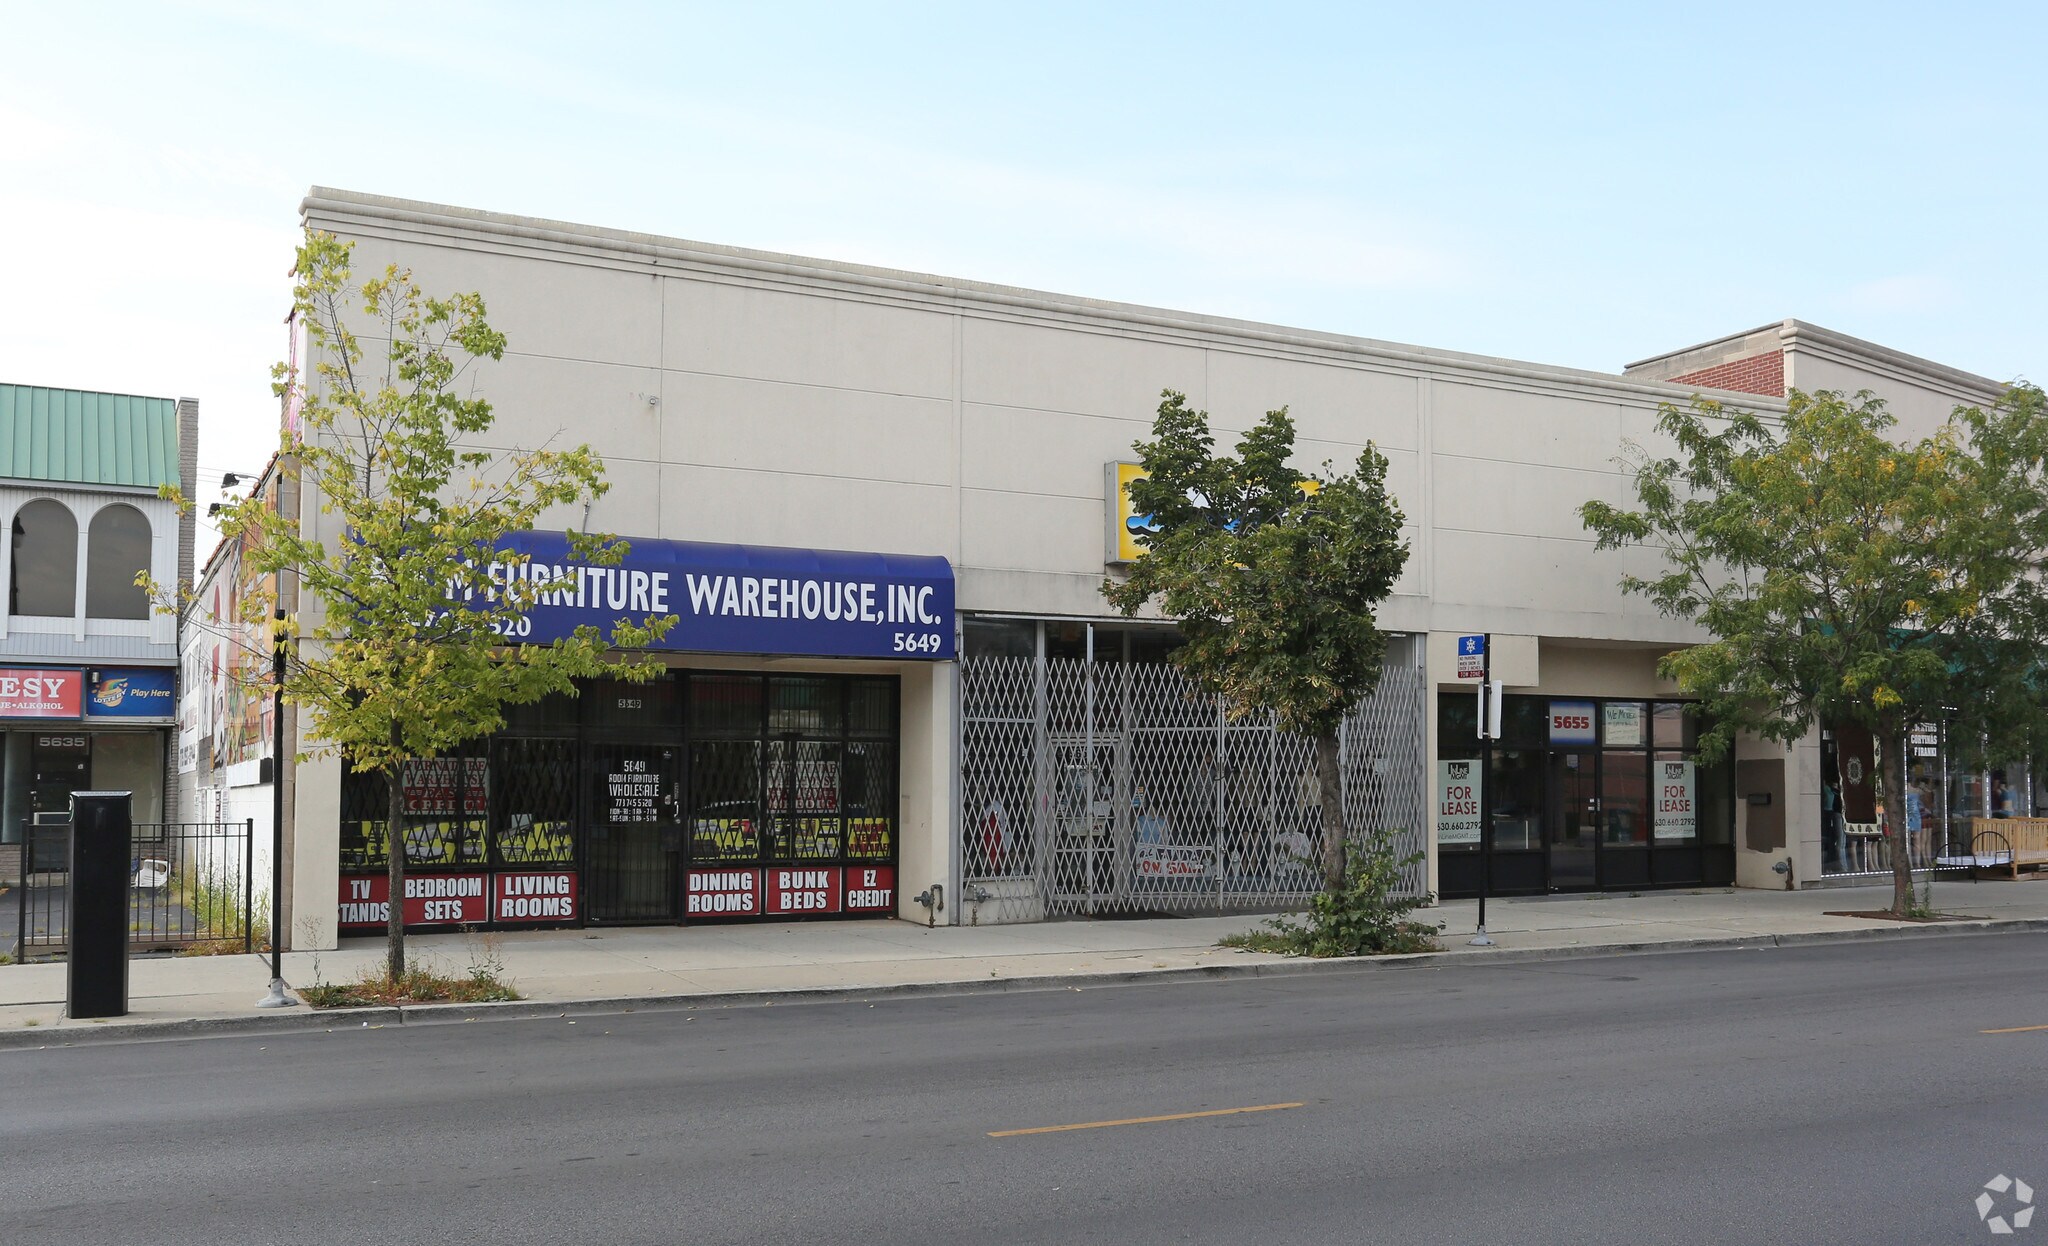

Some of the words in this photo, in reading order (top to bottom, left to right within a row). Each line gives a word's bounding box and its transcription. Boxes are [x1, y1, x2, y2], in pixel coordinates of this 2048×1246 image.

[487, 560, 668, 613] FURNITURE
[893, 632, 942, 653] 5649
[0, 677, 65, 698] ESY
[93, 688, 127, 704] LOTTERY
[130, 688, 150, 698] Play
[150, 689, 170, 697] Here
[1553, 715, 1590, 729] 5655
[39, 737, 86, 747] 5635
[403, 760, 486, 771] FURNITRE
[404, 773, 486, 785] WAREHSE
[608, 784, 660, 797] WHOLESALE
[1447, 786, 1472, 800] FOR
[1664, 785, 1685, 798] FOR
[1441, 801, 1477, 816] LEASE
[1659, 799, 1690, 812] LEASE
[1437, 821, 1482, 831] 630.660.2792
[1655, 817, 1696, 826] 630.660.2792
[1142, 860, 1162, 873] ON
[505, 875, 570, 895] LIVING
[689, 872, 753, 892] DINING
[779, 871, 829, 889] BUNK
[863, 869, 877, 887] EZ
[350, 879, 371, 900] TV
[404, 877, 482, 898] BEDROOM
[501, 897, 573, 918] ROOMS
[688, 894, 754, 913] ROOMS
[780, 891, 828, 910] BEDS
[848, 889, 892, 908] CREDIT
[338, 902, 391, 923] TANDS
[424, 901, 463, 920] SETS
